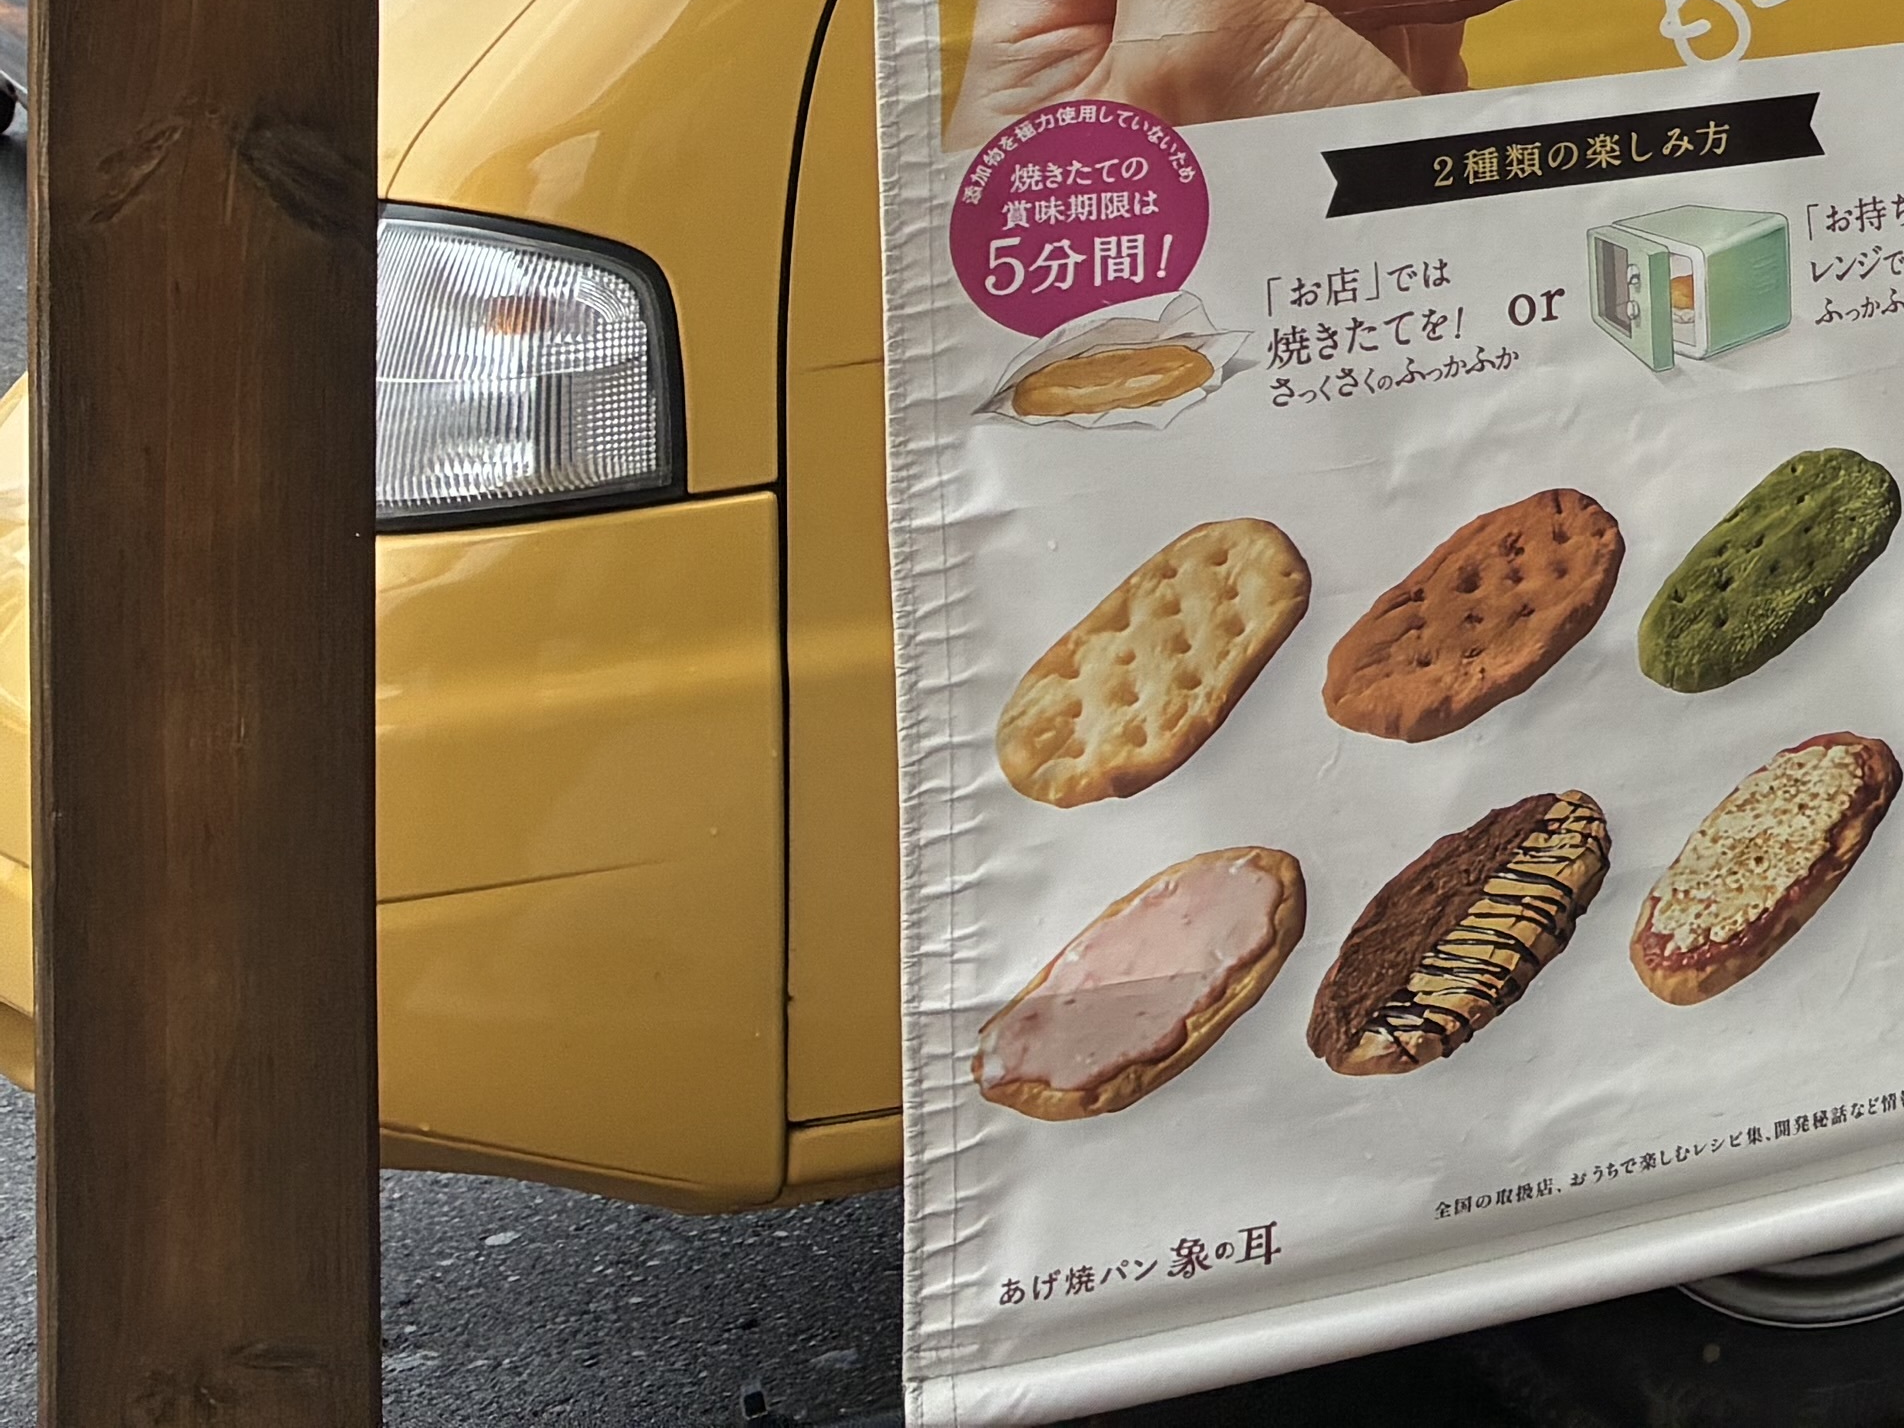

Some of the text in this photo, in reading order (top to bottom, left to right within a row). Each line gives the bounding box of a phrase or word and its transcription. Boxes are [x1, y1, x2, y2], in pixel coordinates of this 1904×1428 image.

[962, 105, 1196, 206] 添加物を極力使用していないため
[1010, 157, 1148, 193] 焼きたての
[1432, 120, 1730, 189] 2種類の楽しみ方
[1002, 190, 1159, 230] 賞味期限は
[985, 234, 1173, 295] 5分間!
[1265, 258, 1451, 318] 「お店」では
[1508, 283, 1565, 325] or
[1267, 306, 1464, 371] 焼きたてを!
[1270, 345, 1519, 408] さっくさくのふっかふか
[1168, 1220, 1282, 1279] 象の耳
